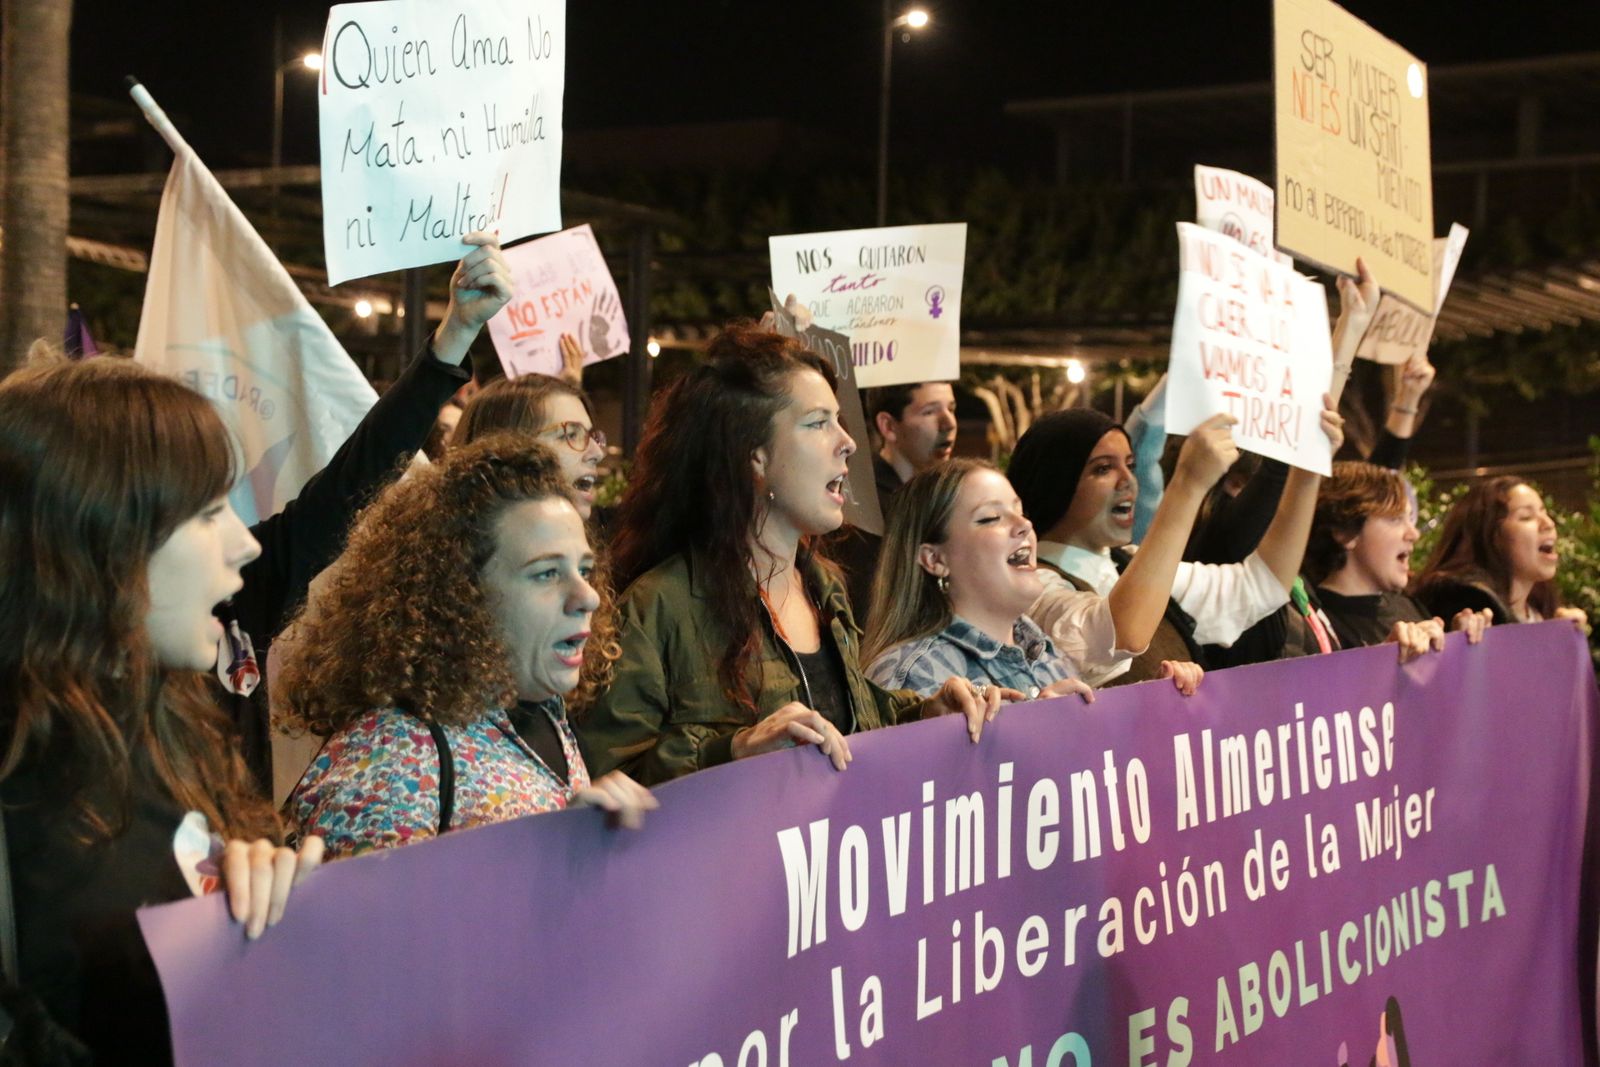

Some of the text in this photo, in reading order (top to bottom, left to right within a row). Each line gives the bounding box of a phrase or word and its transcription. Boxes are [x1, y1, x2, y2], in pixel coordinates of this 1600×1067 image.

[451, 13, 513, 69] Ama
[528, 15, 551, 60] No
[1292, 66, 1314, 124] NO
[1321, 83, 1341, 136] ES
[1301, 30, 1401, 123] SER MUJER
[441, 112, 471, 159] ni
[484, 94, 545, 152] Humilla
[1201, 173, 1231, 200] UN
[347, 206, 375, 249] ni
[796, 245, 927, 274] NOS QUITARON
[822, 273, 886, 293] tanto
[506, 300, 538, 332] NO
[540, 276, 594, 320] ESTÁN
[809, 295, 905, 318] QUE ACABARON
[1199, 341, 1294, 400] VAMOS A
[1222, 391, 1302, 451] TIRAR!
[777, 701, 1395, 959] Movimiento Almeriense
[831, 966, 884, 1061] la
[917, 856, 1228, 1021] Liberación
[1243, 829, 1290, 901] de
[1305, 813, 1340, 879] la
[1356, 786, 1436, 860] Mujer
[1129, 863, 1507, 1067] ES ABOLICIONISTA
